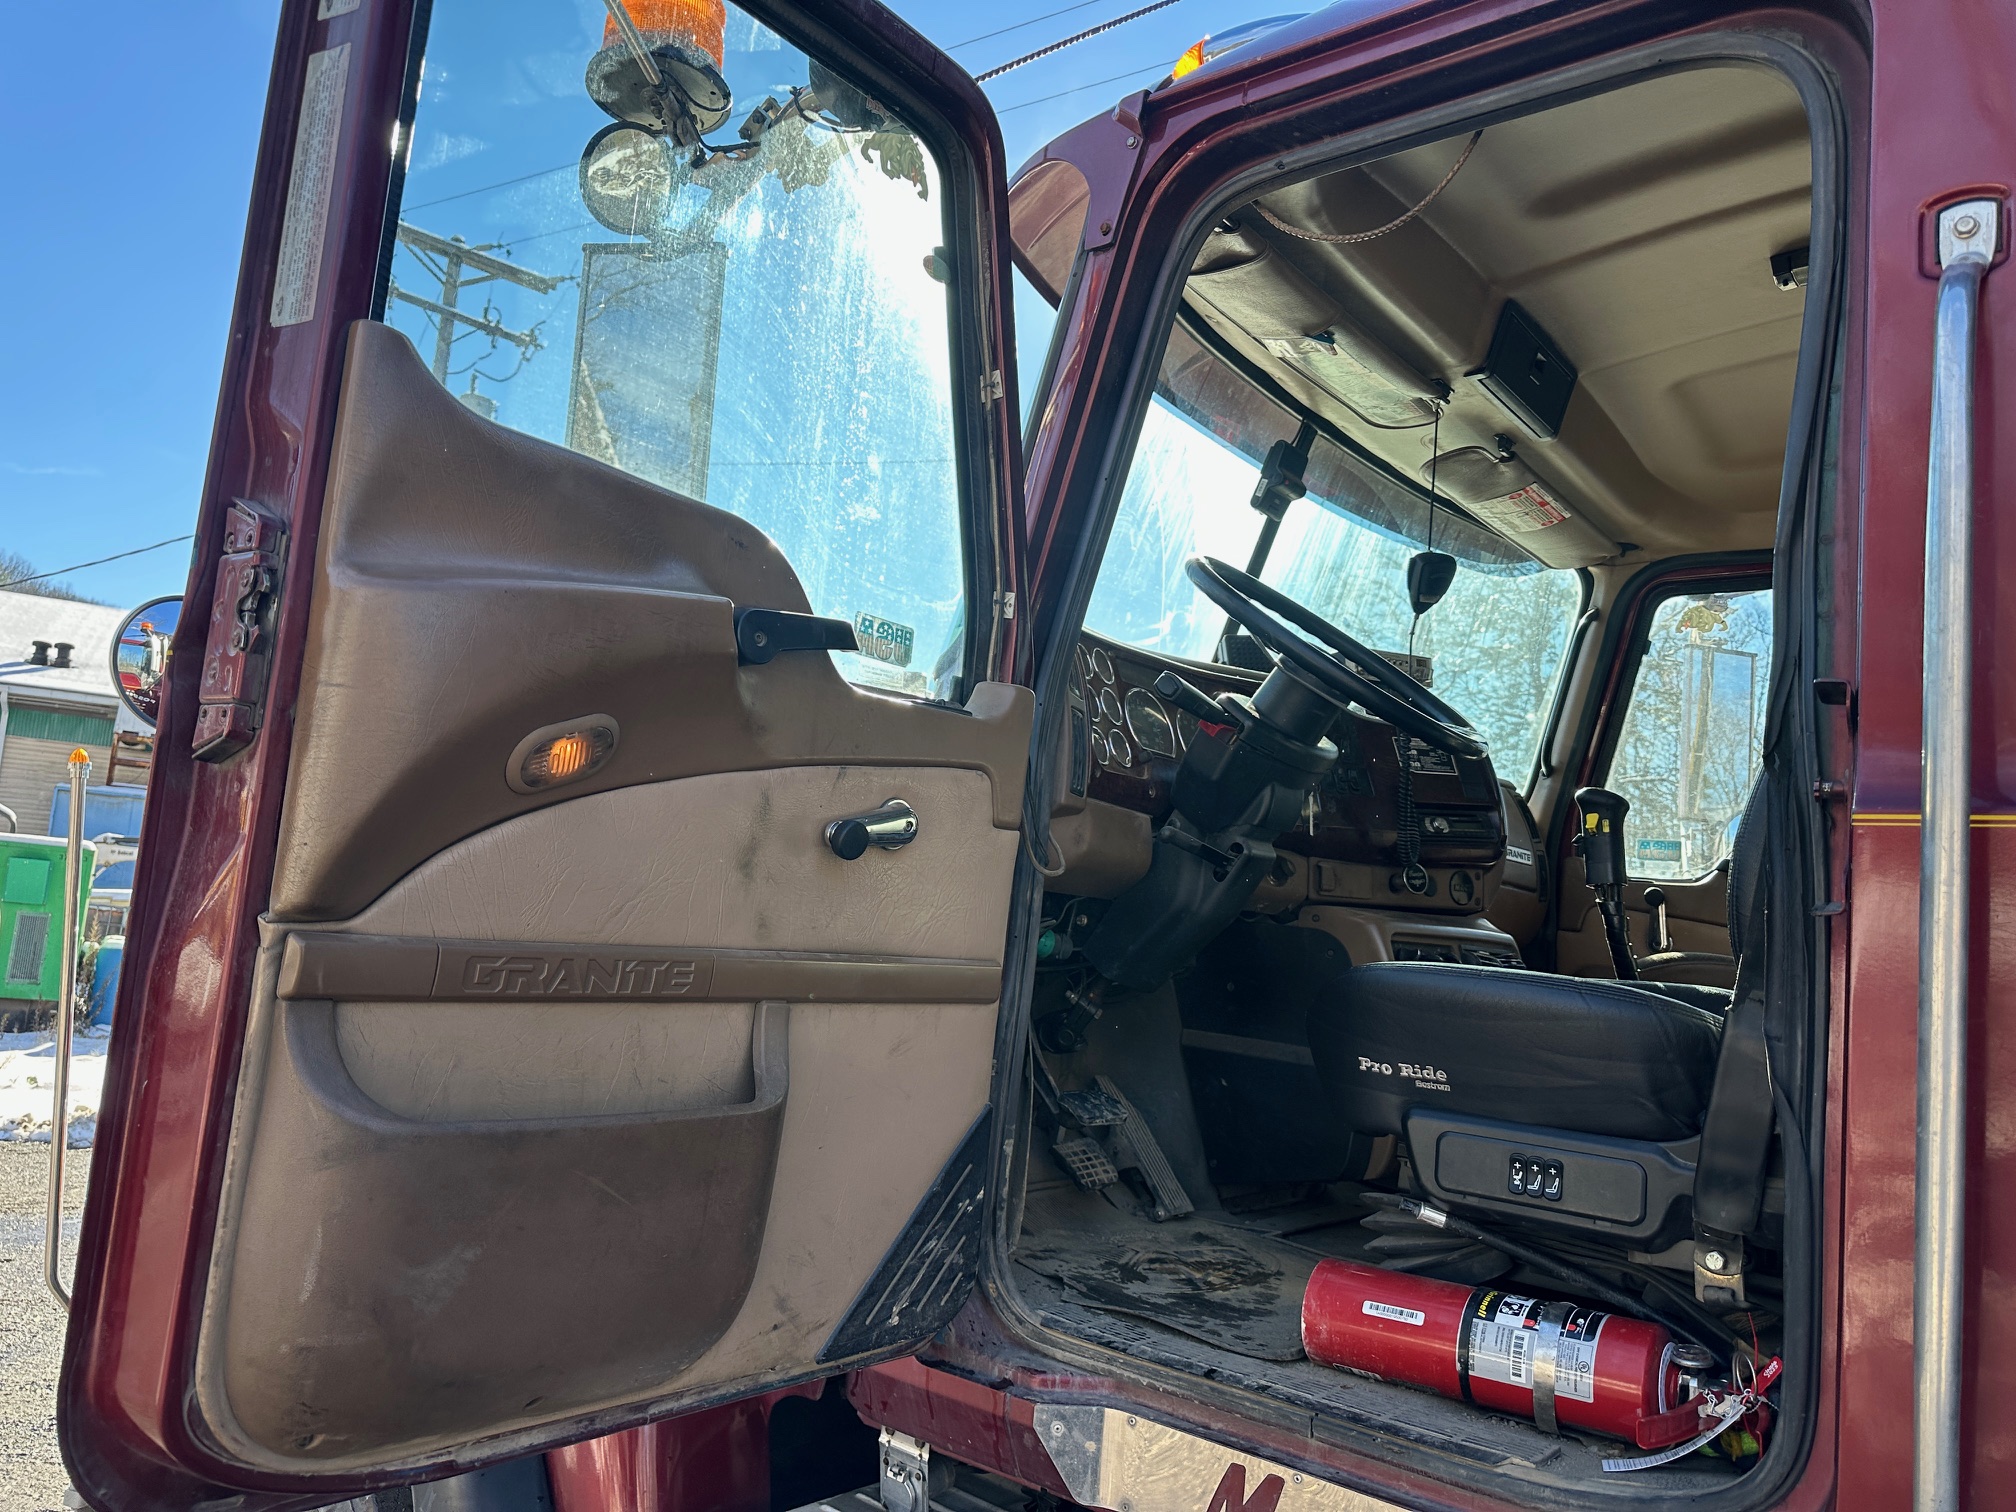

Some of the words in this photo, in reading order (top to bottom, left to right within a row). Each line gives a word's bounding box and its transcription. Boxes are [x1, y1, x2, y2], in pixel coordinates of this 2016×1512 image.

[1507, 848, 1531, 862] RANITE
[462, 955, 696, 995] GRANITE
[1358, 1056, 1393, 1076] Pro
[1397, 1062, 1448, 1082] Ride
